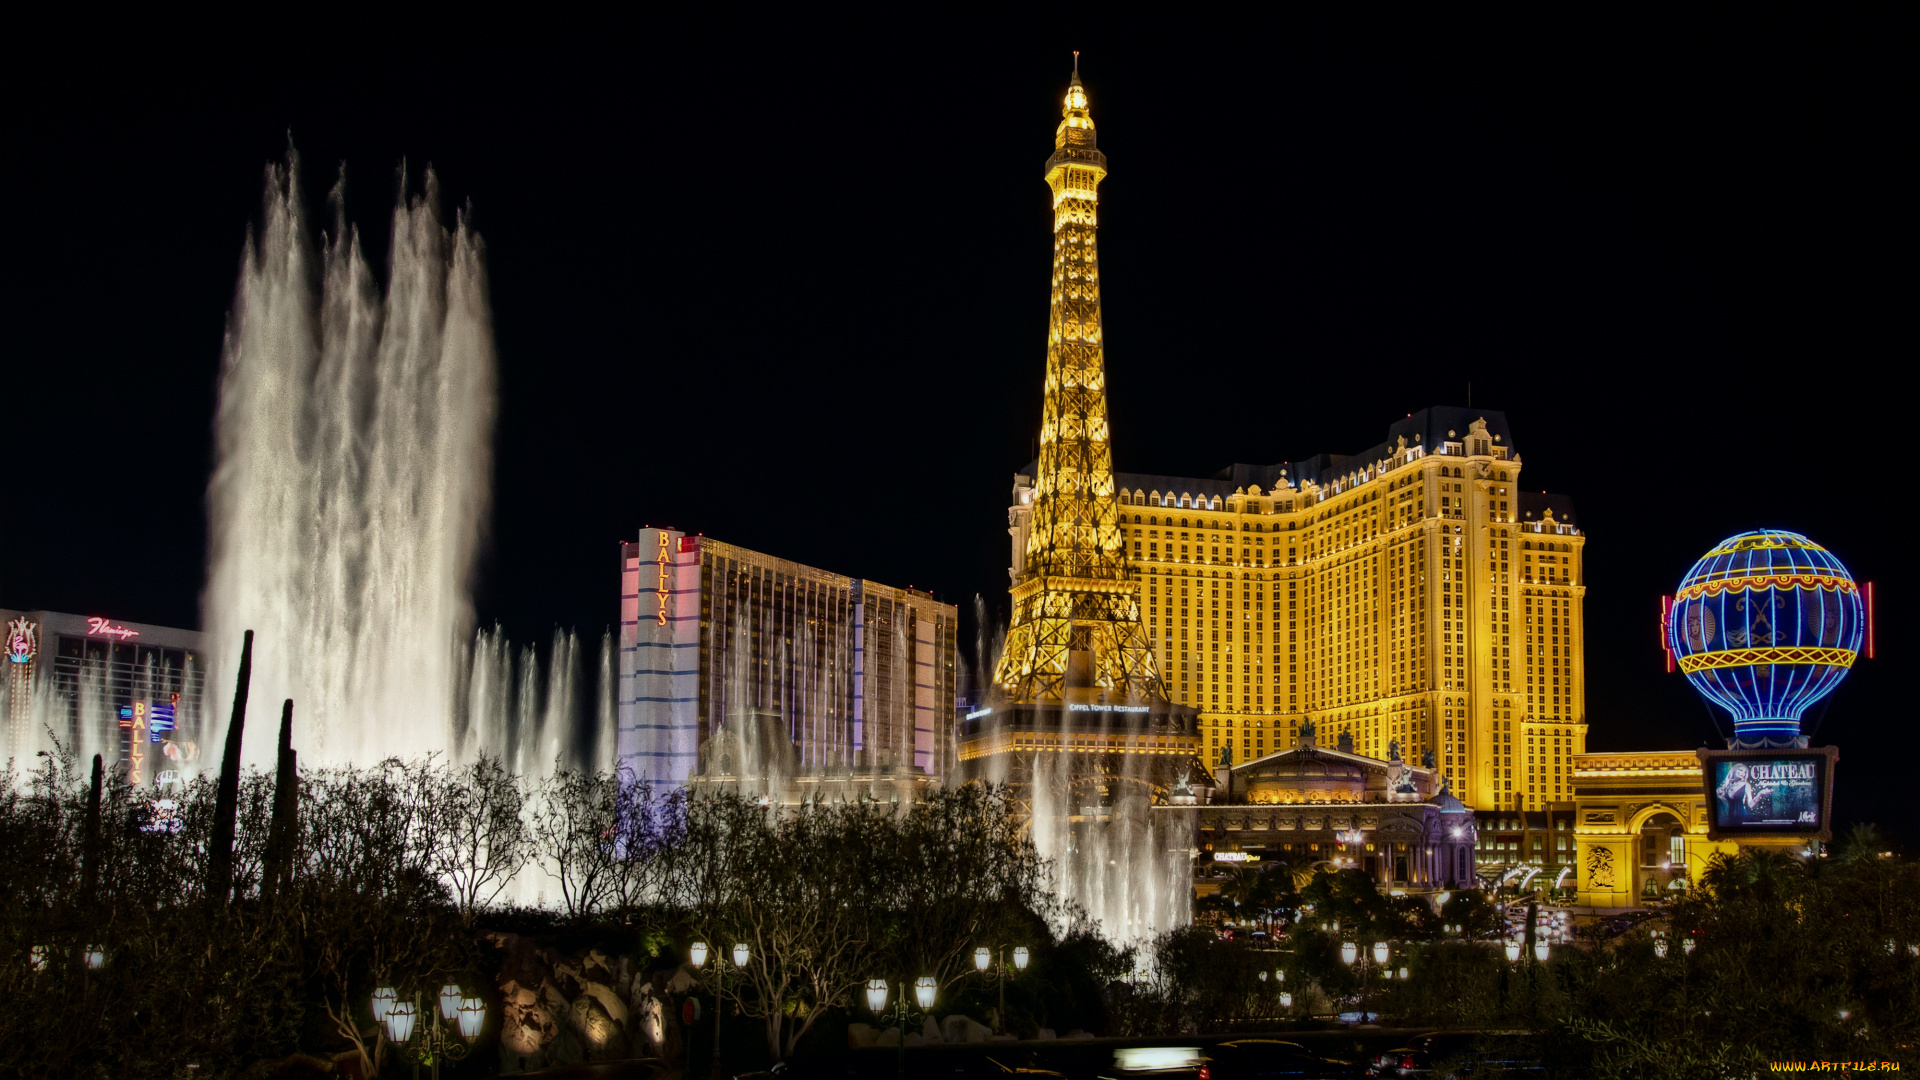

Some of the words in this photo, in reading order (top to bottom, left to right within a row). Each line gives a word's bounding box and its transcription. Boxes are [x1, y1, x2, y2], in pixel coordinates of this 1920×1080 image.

[87, 617, 139, 640] Flamingo
[1114, 705, 1150, 713] RESTAURANT
[1750, 764, 1815, 780] CHATEAU
